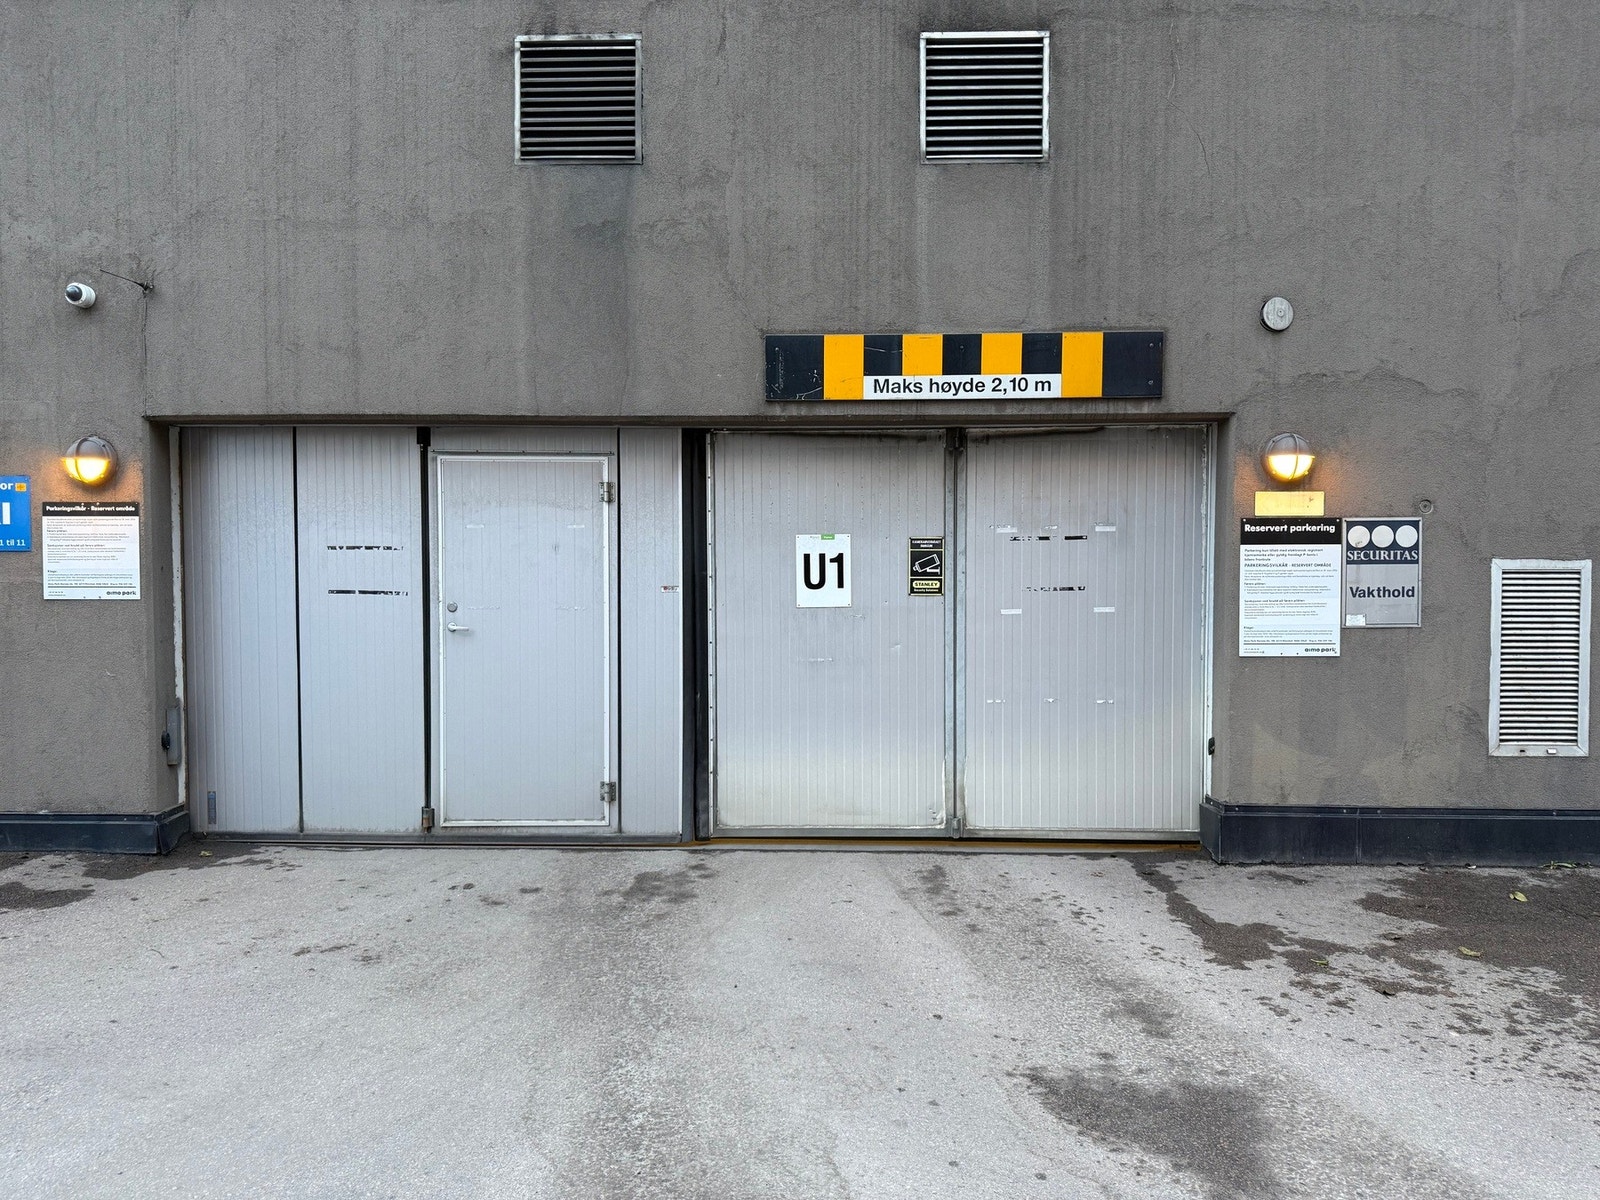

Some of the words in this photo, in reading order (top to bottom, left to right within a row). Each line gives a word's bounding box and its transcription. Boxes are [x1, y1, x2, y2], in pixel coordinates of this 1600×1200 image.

[873, 378, 923, 394] Maks
[929, 376, 986, 396] høyde
[991, 377, 1030, 395] 2,10
[1034, 380, 1052, 393] m
[1244, 524, 1289, 532] Reservert
[1290, 523, 1336, 534] parkering
[1347, 550, 1418, 561] SECURITAS
[804, 553, 844, 589] U1
[1350, 586, 1415, 599] Vakthold
